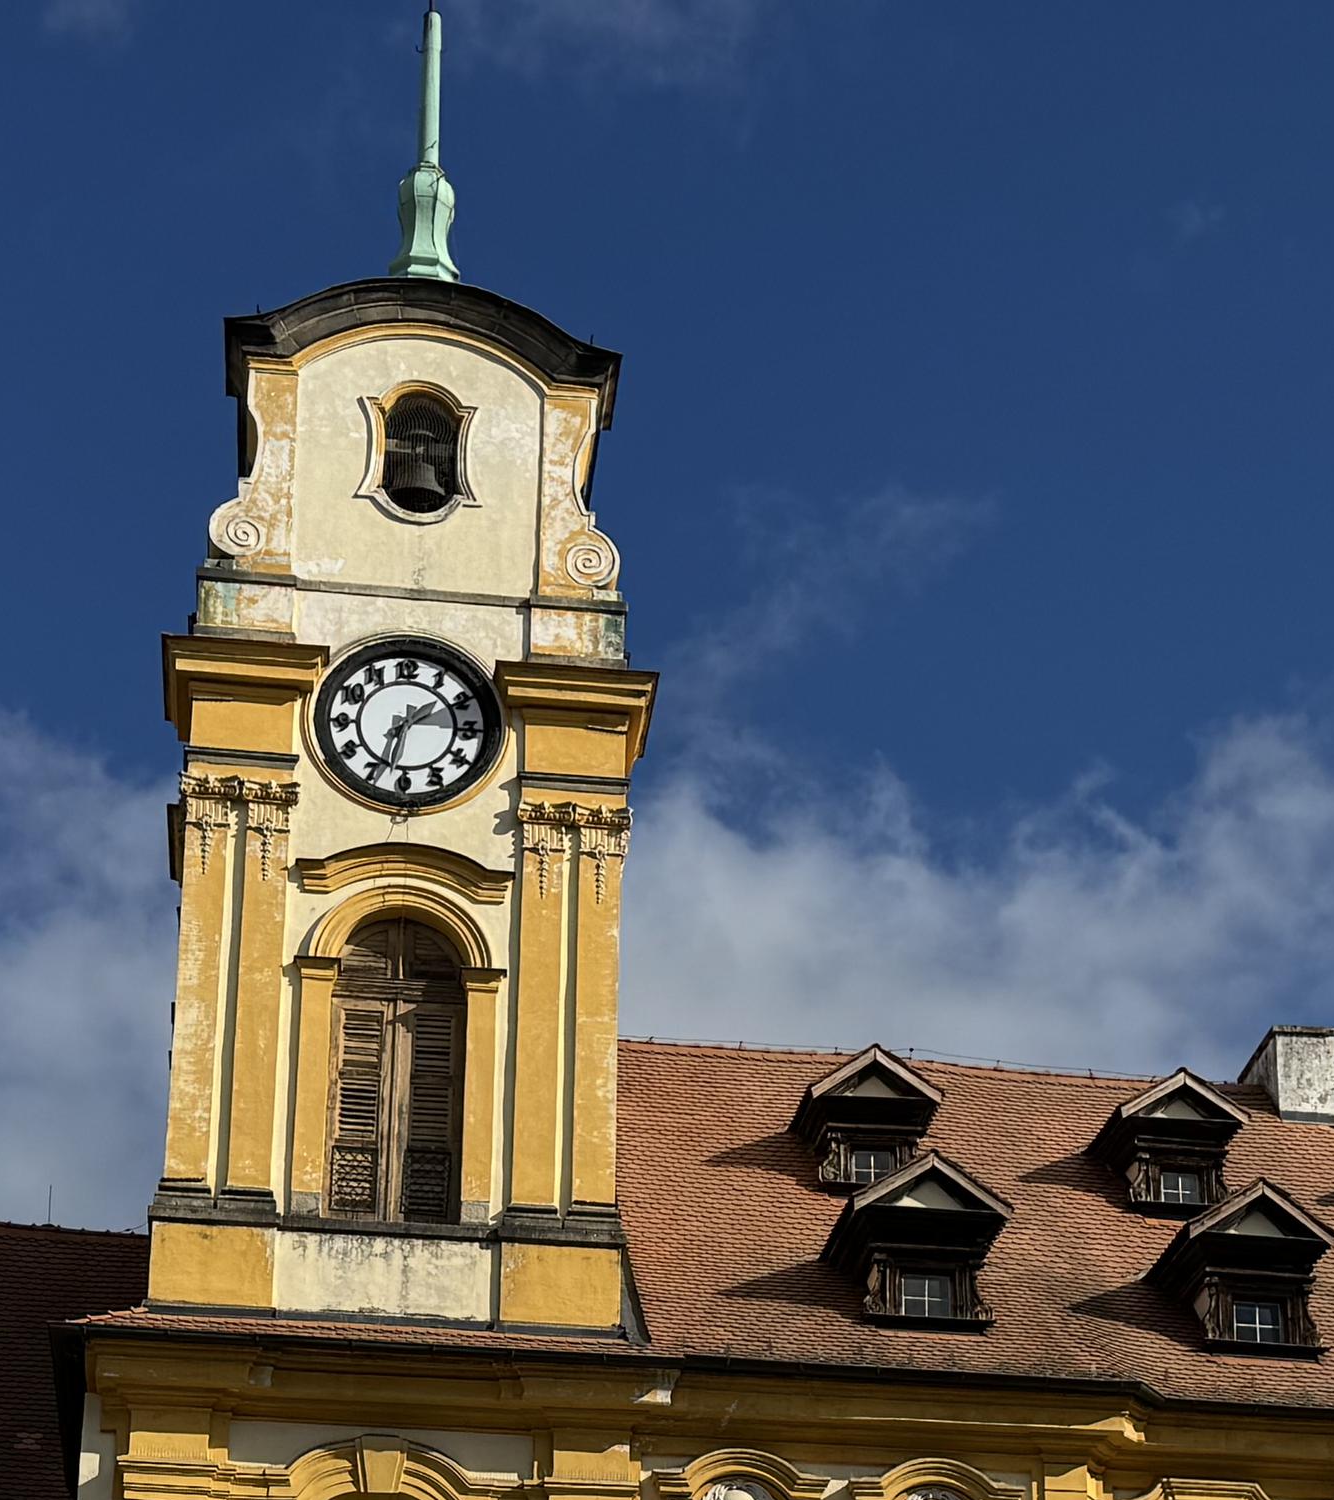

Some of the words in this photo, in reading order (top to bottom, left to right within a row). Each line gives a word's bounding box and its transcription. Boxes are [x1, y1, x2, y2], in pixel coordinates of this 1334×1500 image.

[364, 665, 385, 687] 11
[395, 660, 419, 681] 12
[432, 671, 445, 690] 1
[341, 683, 365, 705] 10
[453, 691, 471, 710] 2
[332, 712, 350, 733] 9
[458, 721, 478, 741] 3
[340, 740, 357, 759] 8
[450, 748, 472, 768] 4
[364, 762, 379, 782] 7
[394, 771, 412, 793] 6
[426, 766, 445, 788] 5
